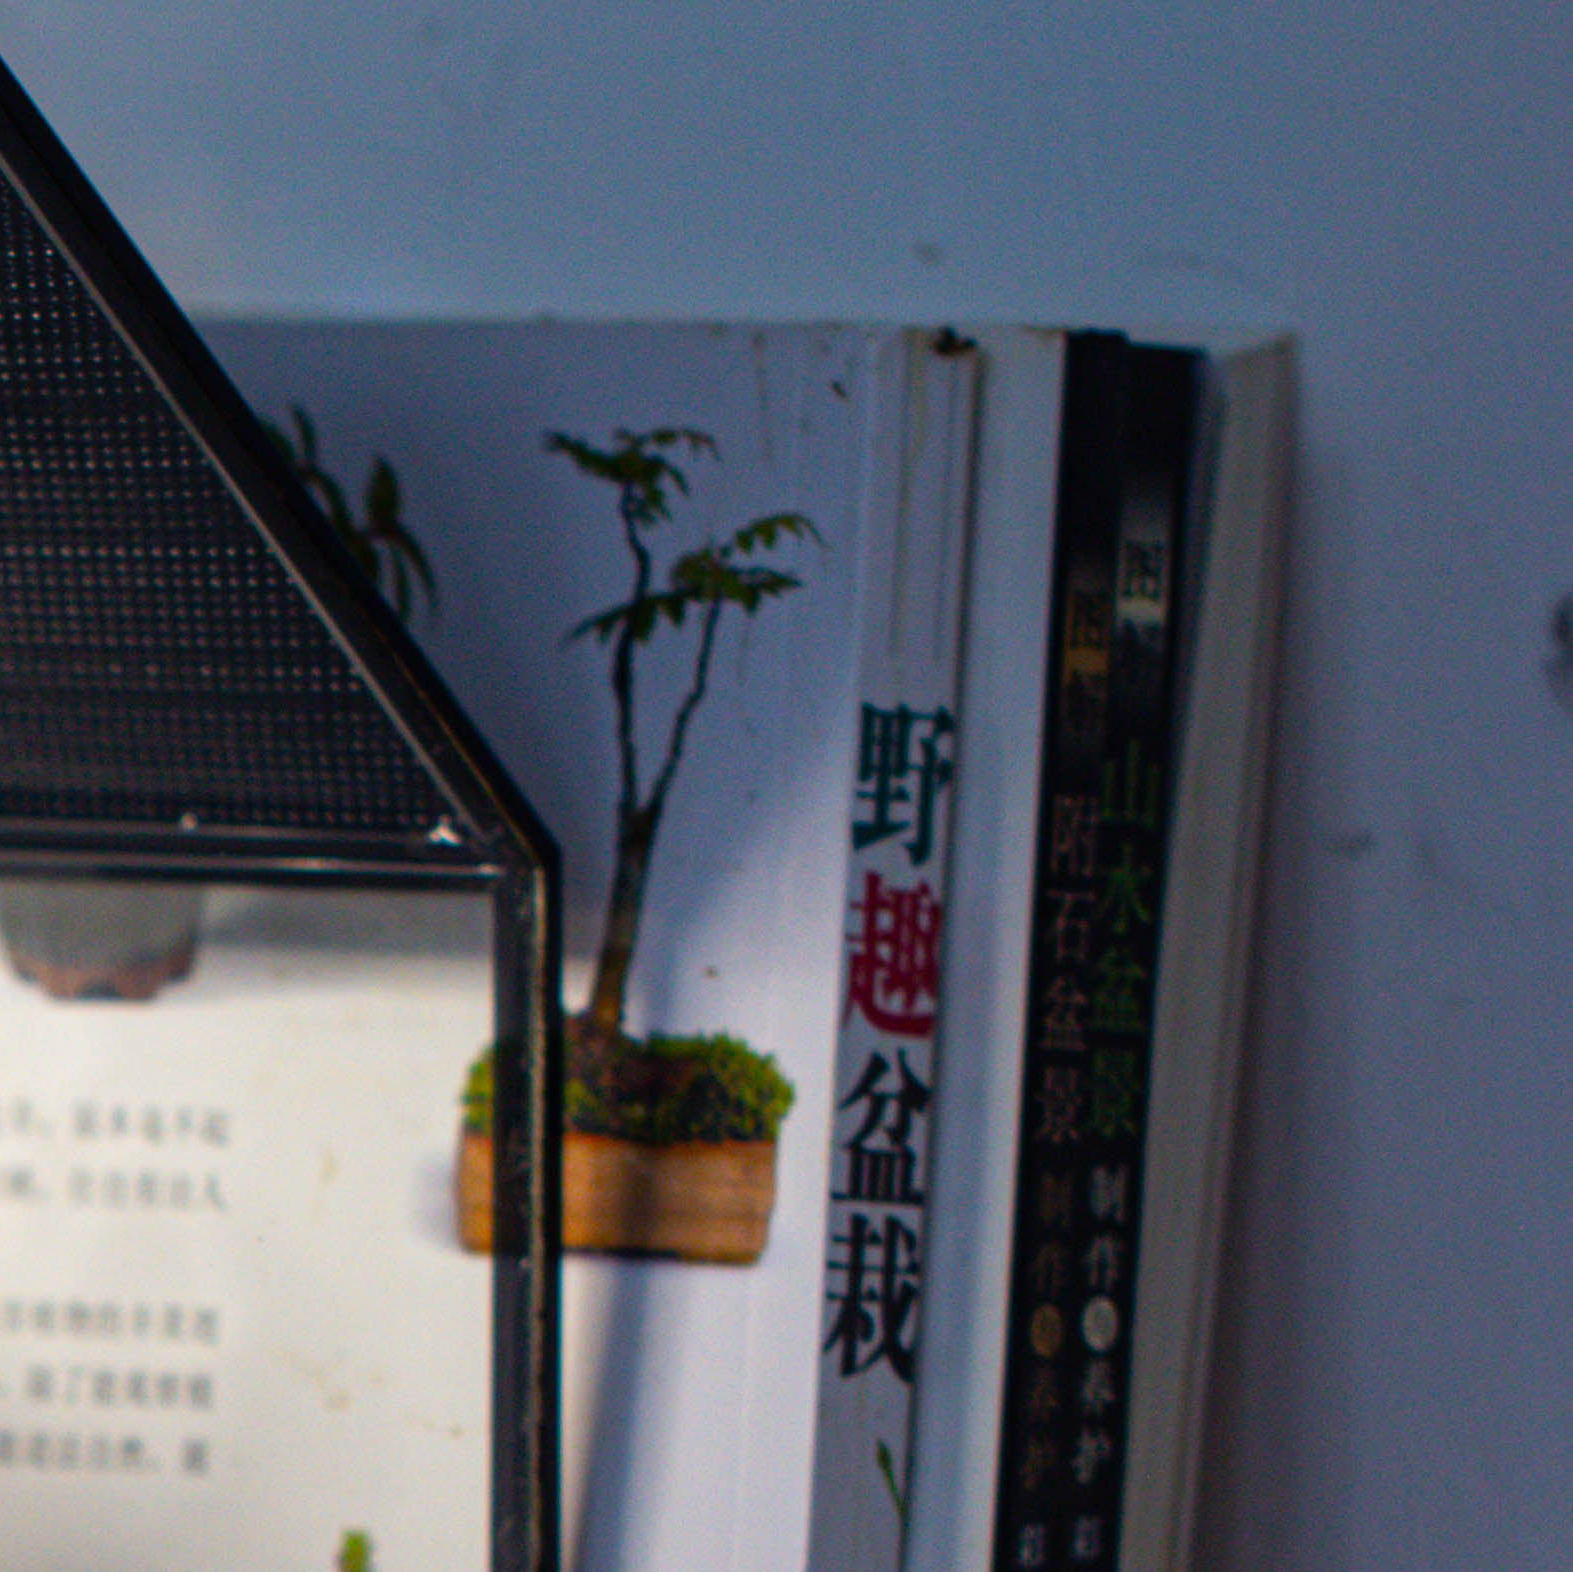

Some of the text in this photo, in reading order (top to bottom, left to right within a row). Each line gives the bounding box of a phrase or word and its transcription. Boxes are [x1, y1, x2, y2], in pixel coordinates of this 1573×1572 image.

[822, 703, 954, 1382] 野趣盆栽
[1089, 737, 1159, 1140] 山水盆景
